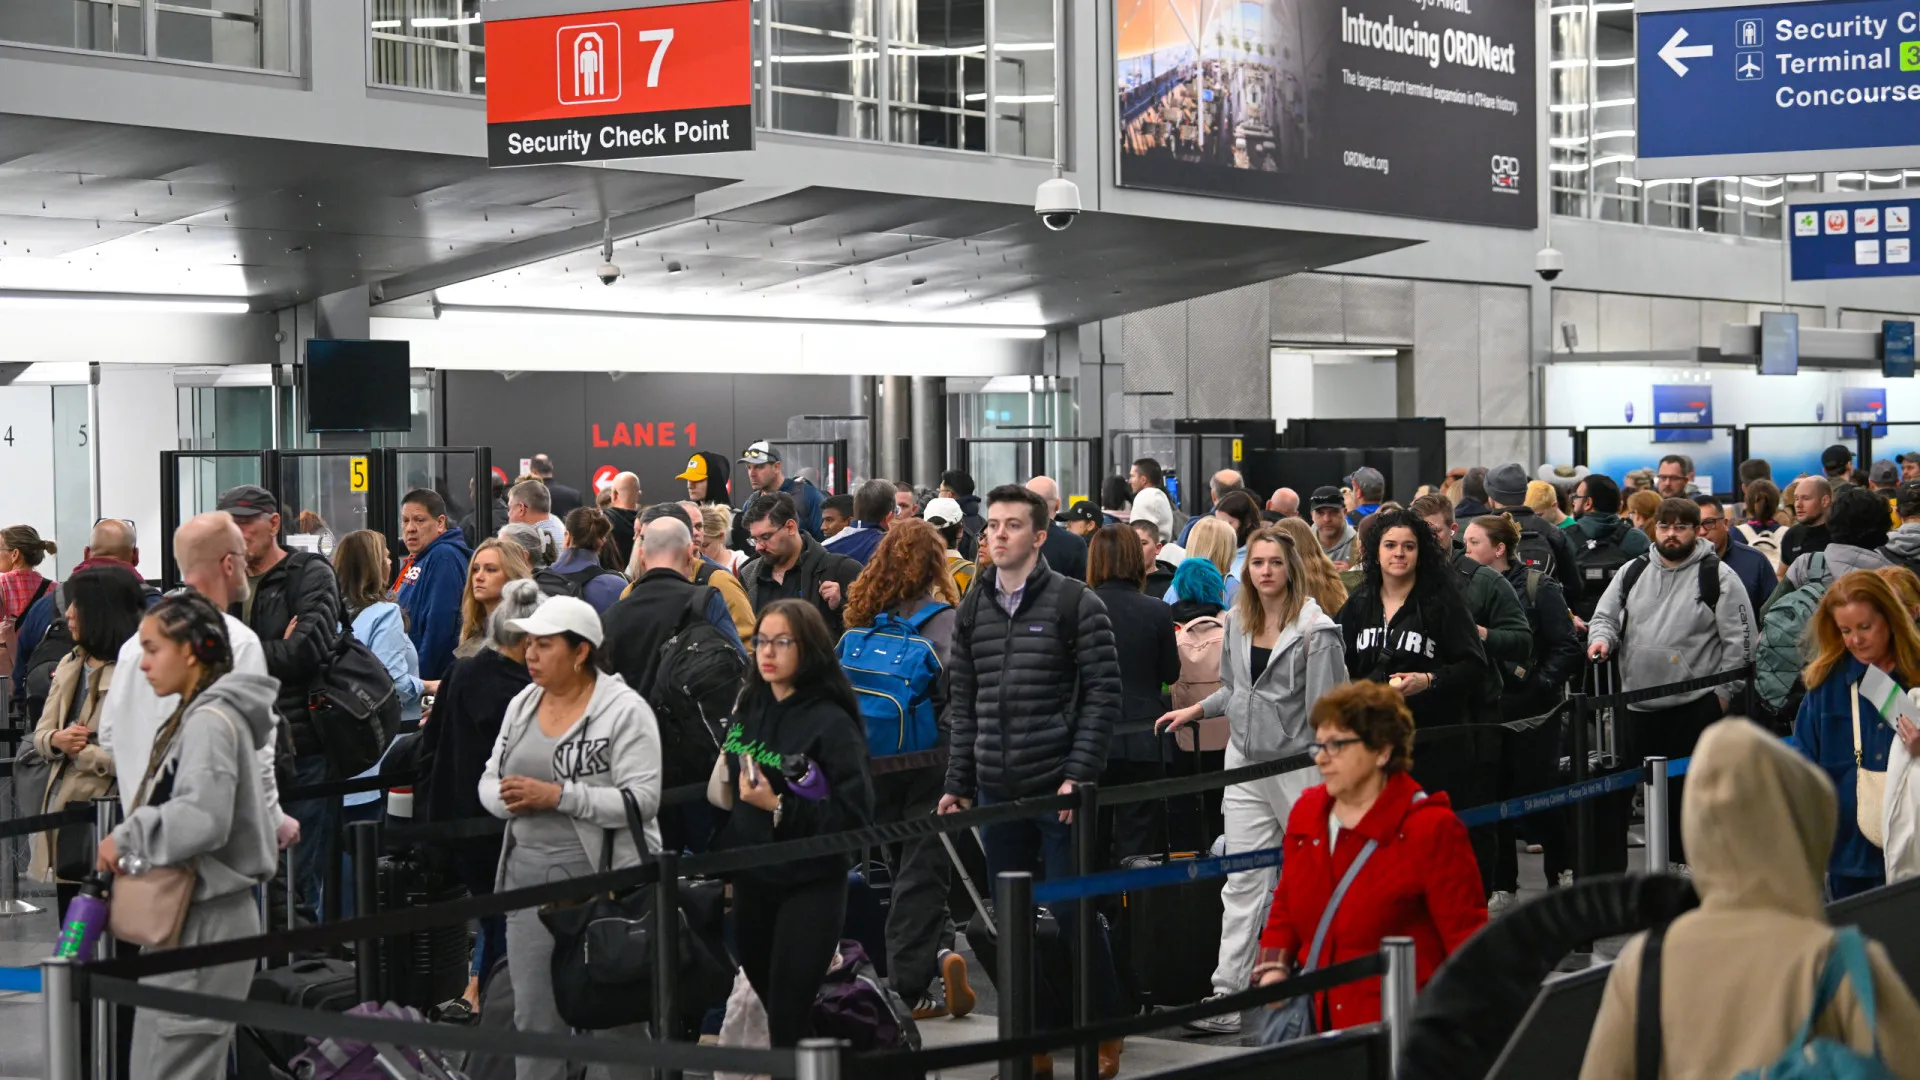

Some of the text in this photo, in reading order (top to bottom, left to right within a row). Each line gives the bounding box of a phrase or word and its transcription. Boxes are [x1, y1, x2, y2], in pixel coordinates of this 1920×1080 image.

[1341, 6, 1516, 74] Introducing ORDNext
[1775, 15, 1888, 41] Security
[638, 28, 675, 88] 7
[1775, 47, 1891, 74] Terminal
[1341, 68, 1356, 86] The
[1356, 71, 1382, 92] largest
[1382, 76, 1405, 96] airport
[1405, 80, 1434, 99] terminal
[1434, 87, 1466, 104] expansion
[1467, 90, 1474, 106] in
[507, 119, 730, 155] Security Check Point
[1343, 150, 1389, 175] ORDNext.org
[1491, 154, 1520, 176] ORD
[1491, 174, 1520, 188] NEXT
[3, 425, 15, 447] 4
[78, 423, 88, 447] 5
[592, 421, 697, 449] LANE 1
[353, 461, 365, 489] 5
